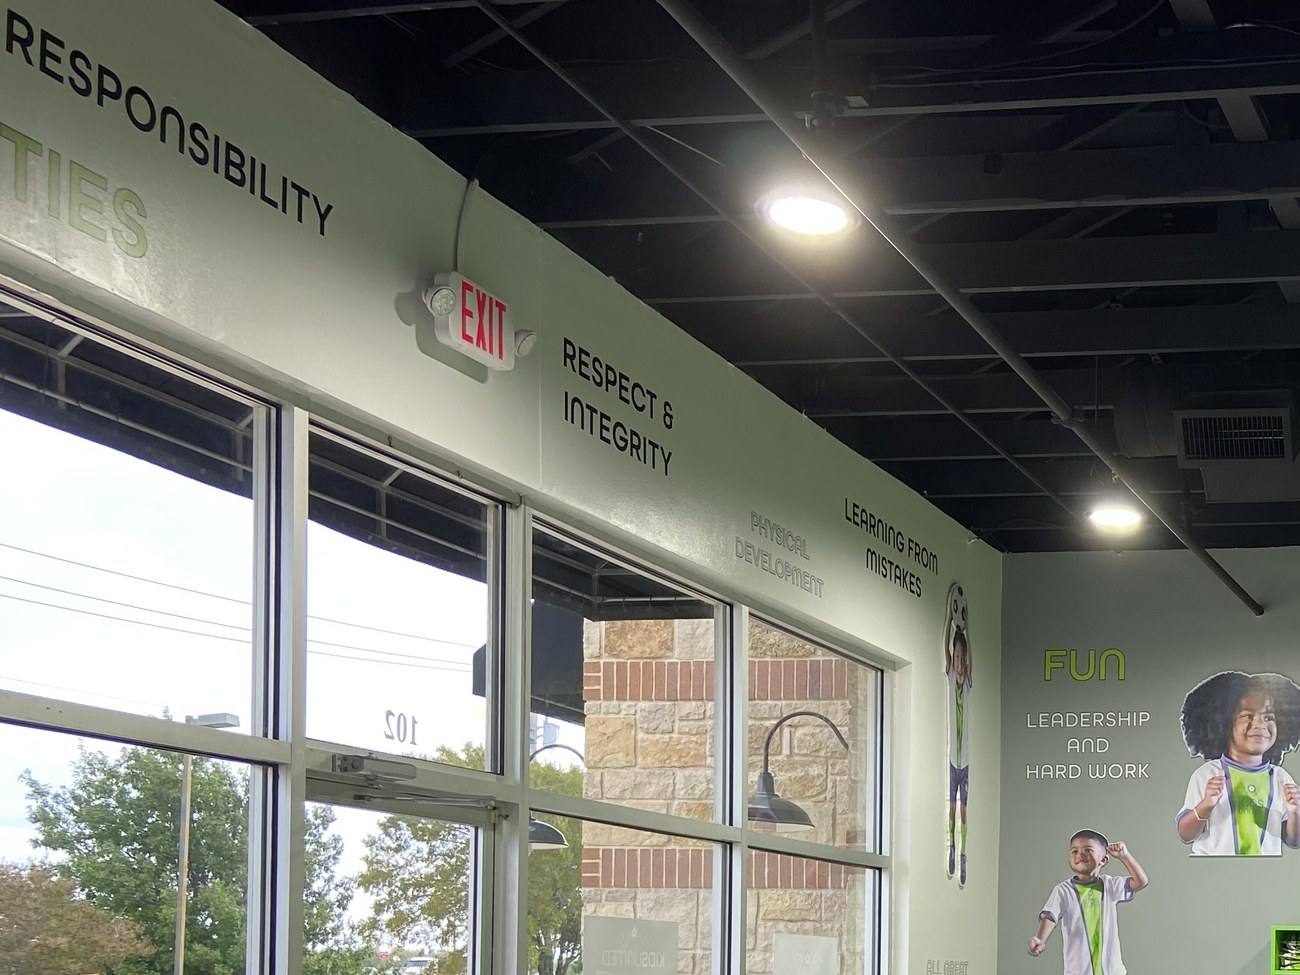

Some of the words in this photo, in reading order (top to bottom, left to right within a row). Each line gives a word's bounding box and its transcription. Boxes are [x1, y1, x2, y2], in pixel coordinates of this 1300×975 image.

[5, 8, 334, 237] RESPONSIBILITY
[0, 121, 149, 259] TIES
[460, 280, 507, 361] EXIT
[563, 337, 657, 420] RESPECT
[662, 400, 674, 430] &
[564, 391, 673, 476] INTEGRITY
[734, 535, 825, 599] DEVELOPMENT
[750, 510, 810, 561] PHYSICAL
[844, 497, 905, 552] LEARNING
[907, 538, 939, 576] FROM
[865, 547, 922, 598] MISTAKES
[1043, 647, 1127, 682] FUN
[1025, 711, 1152, 729] LEADERSHIP
[1066, 737, 1110, 753] AND
[1025, 764, 1082, 780] HARD
[1088, 763, 1151, 780] WORK
